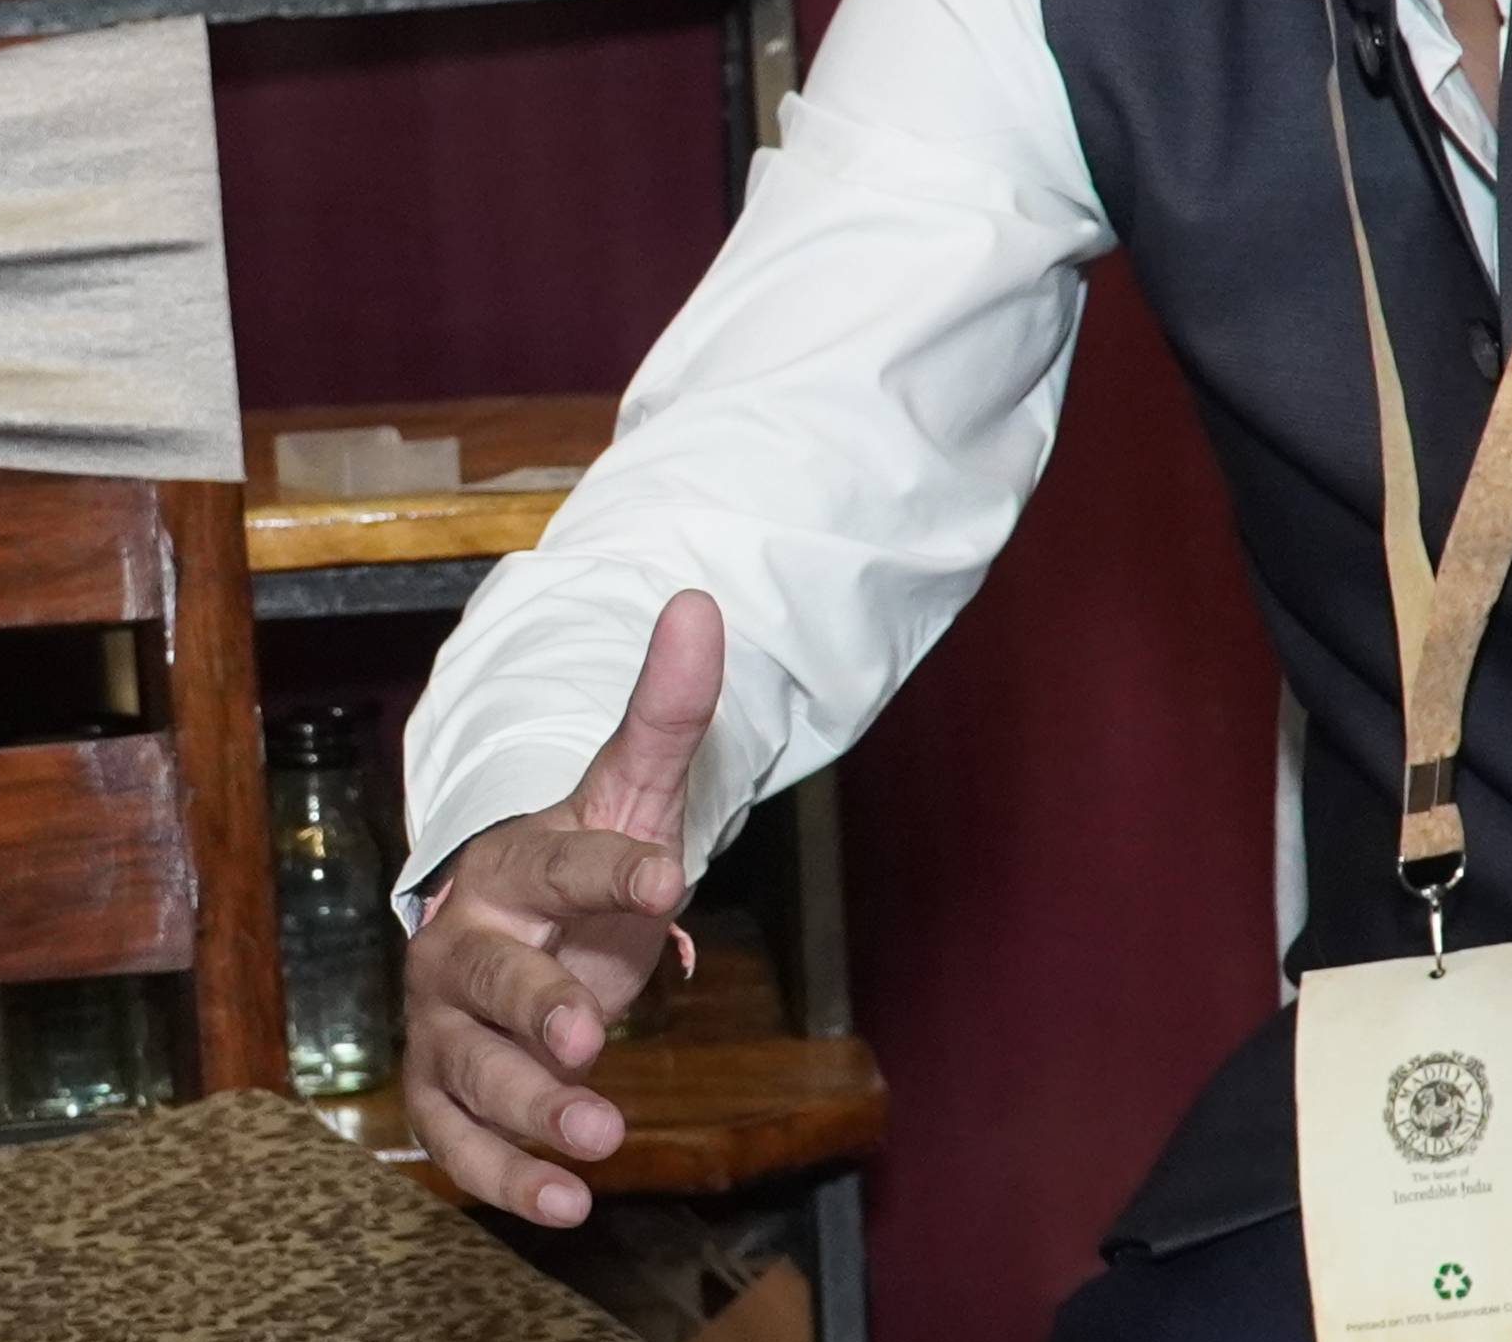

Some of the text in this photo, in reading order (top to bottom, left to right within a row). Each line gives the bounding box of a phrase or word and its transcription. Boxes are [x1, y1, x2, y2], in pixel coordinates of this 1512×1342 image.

[1398, 1063, 1473, 1099] MADHYA
[1395, 1110, 1480, 1153] PRADESH
[1393, 1184, 1459, 1205] Incredible
